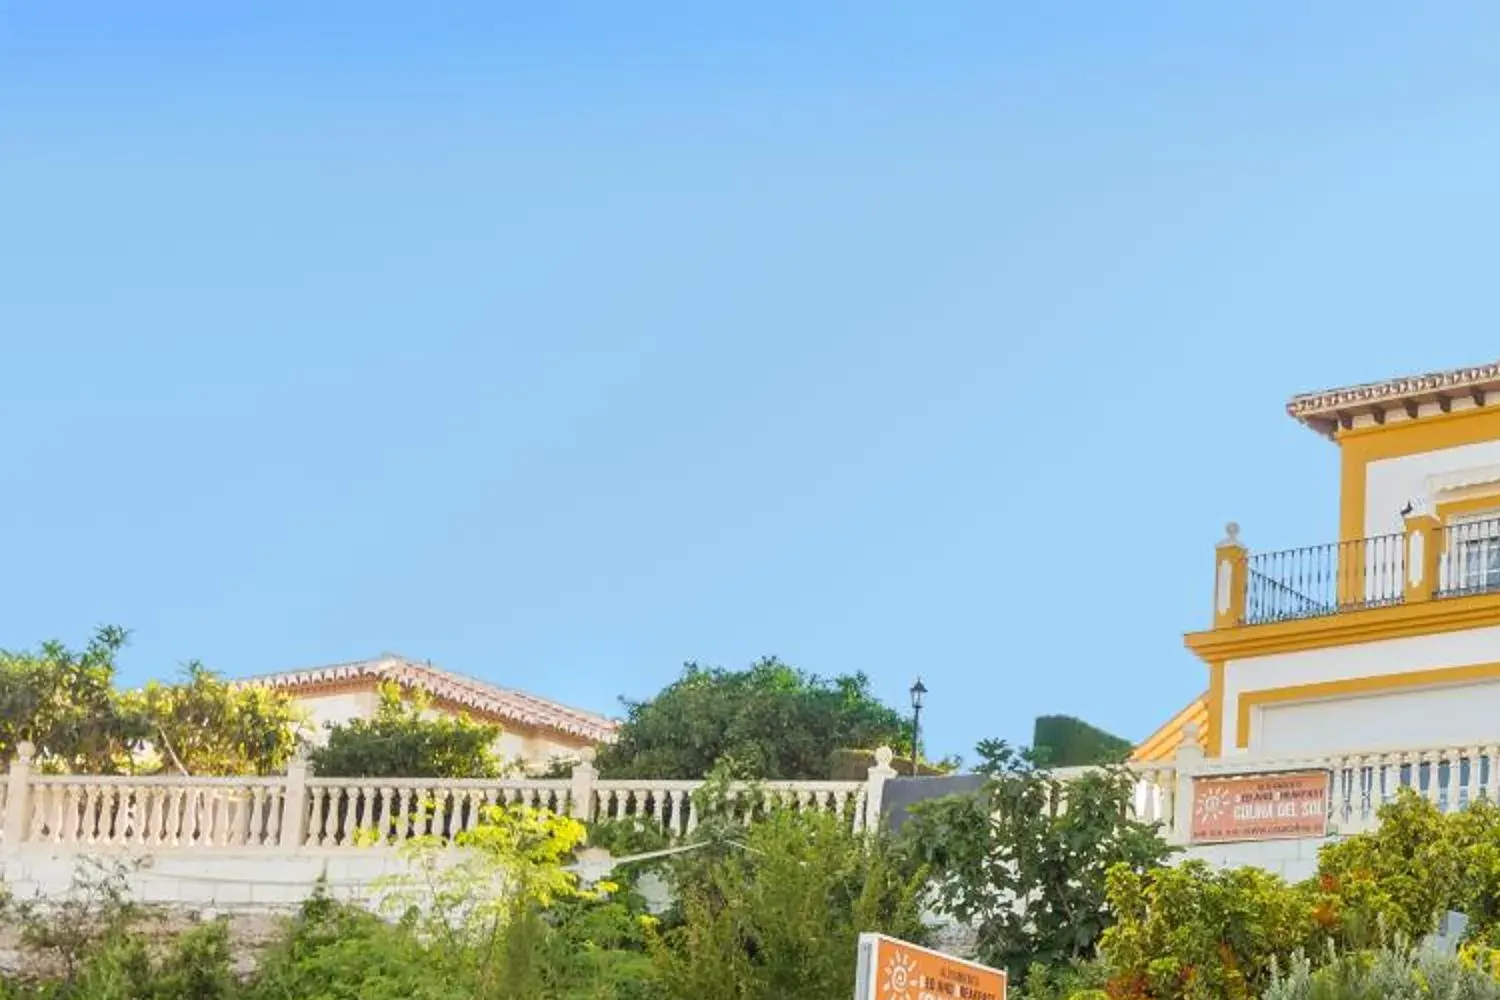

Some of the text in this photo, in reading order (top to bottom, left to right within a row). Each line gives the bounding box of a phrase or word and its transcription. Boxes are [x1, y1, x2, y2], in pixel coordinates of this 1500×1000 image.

[1234, 799, 1325, 820] COLINA DEL SOL
